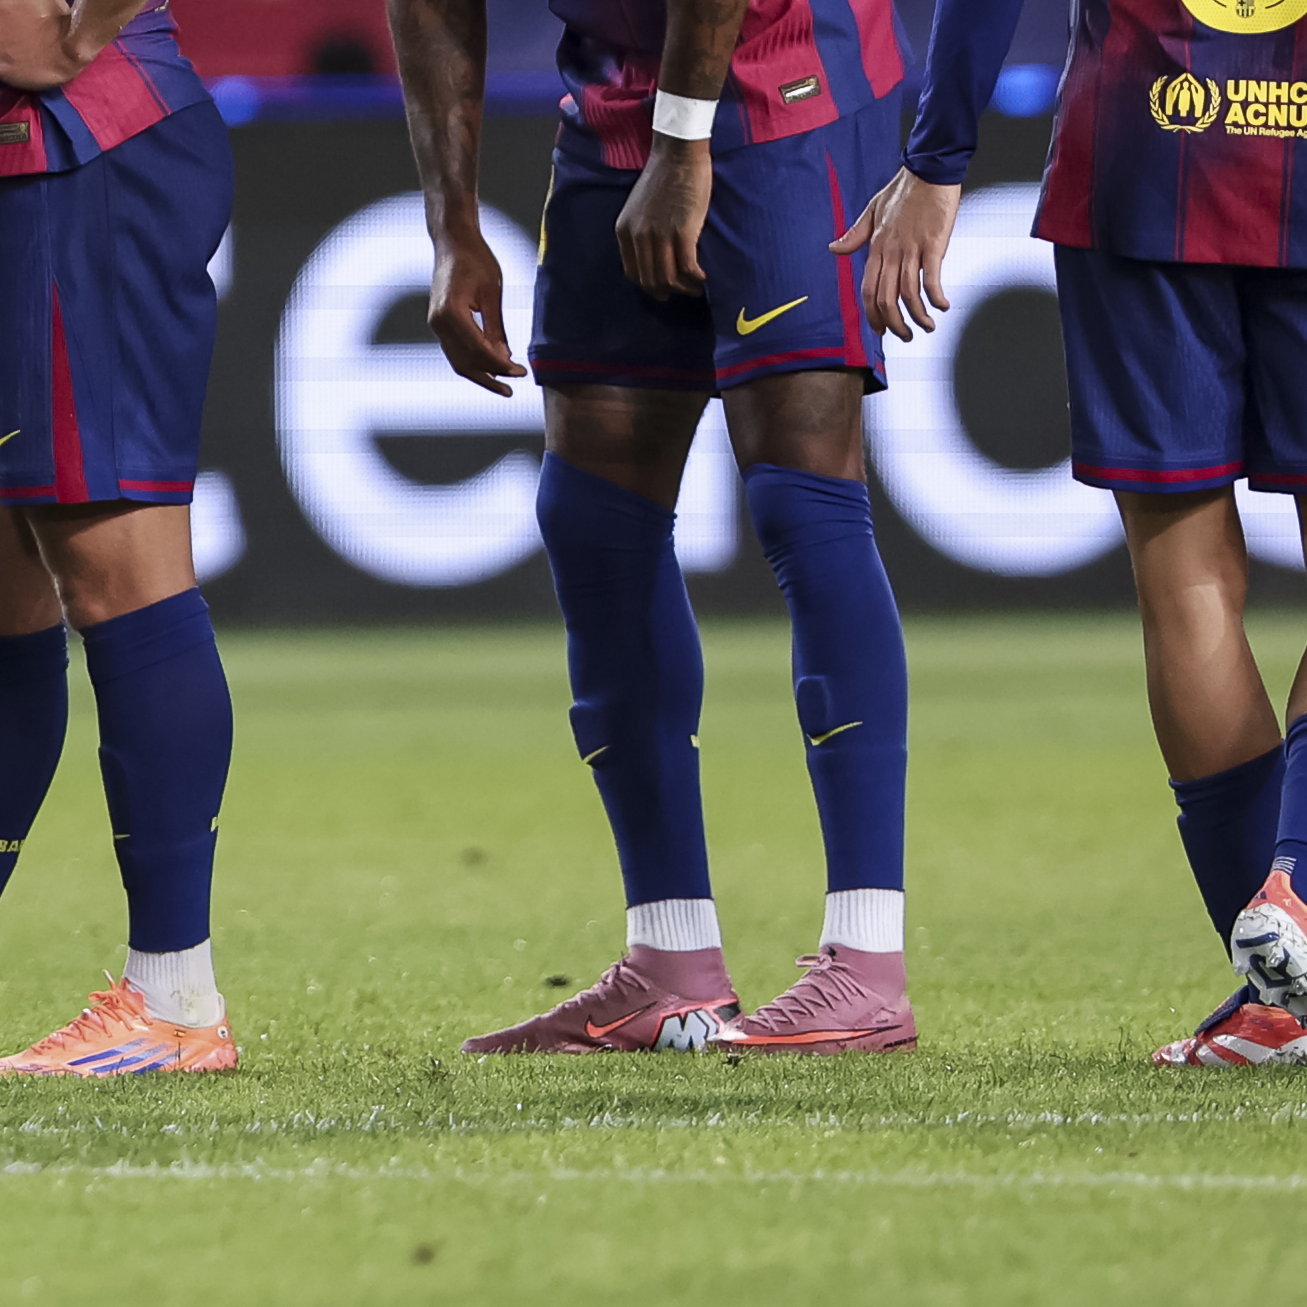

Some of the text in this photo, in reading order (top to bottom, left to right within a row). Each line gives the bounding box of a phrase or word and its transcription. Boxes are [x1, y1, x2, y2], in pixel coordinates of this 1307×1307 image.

[1225, 125, 1242, 135] The
[1243, 126, 1257, 136] UN
[1259, 127, 1295, 138] Refugee
